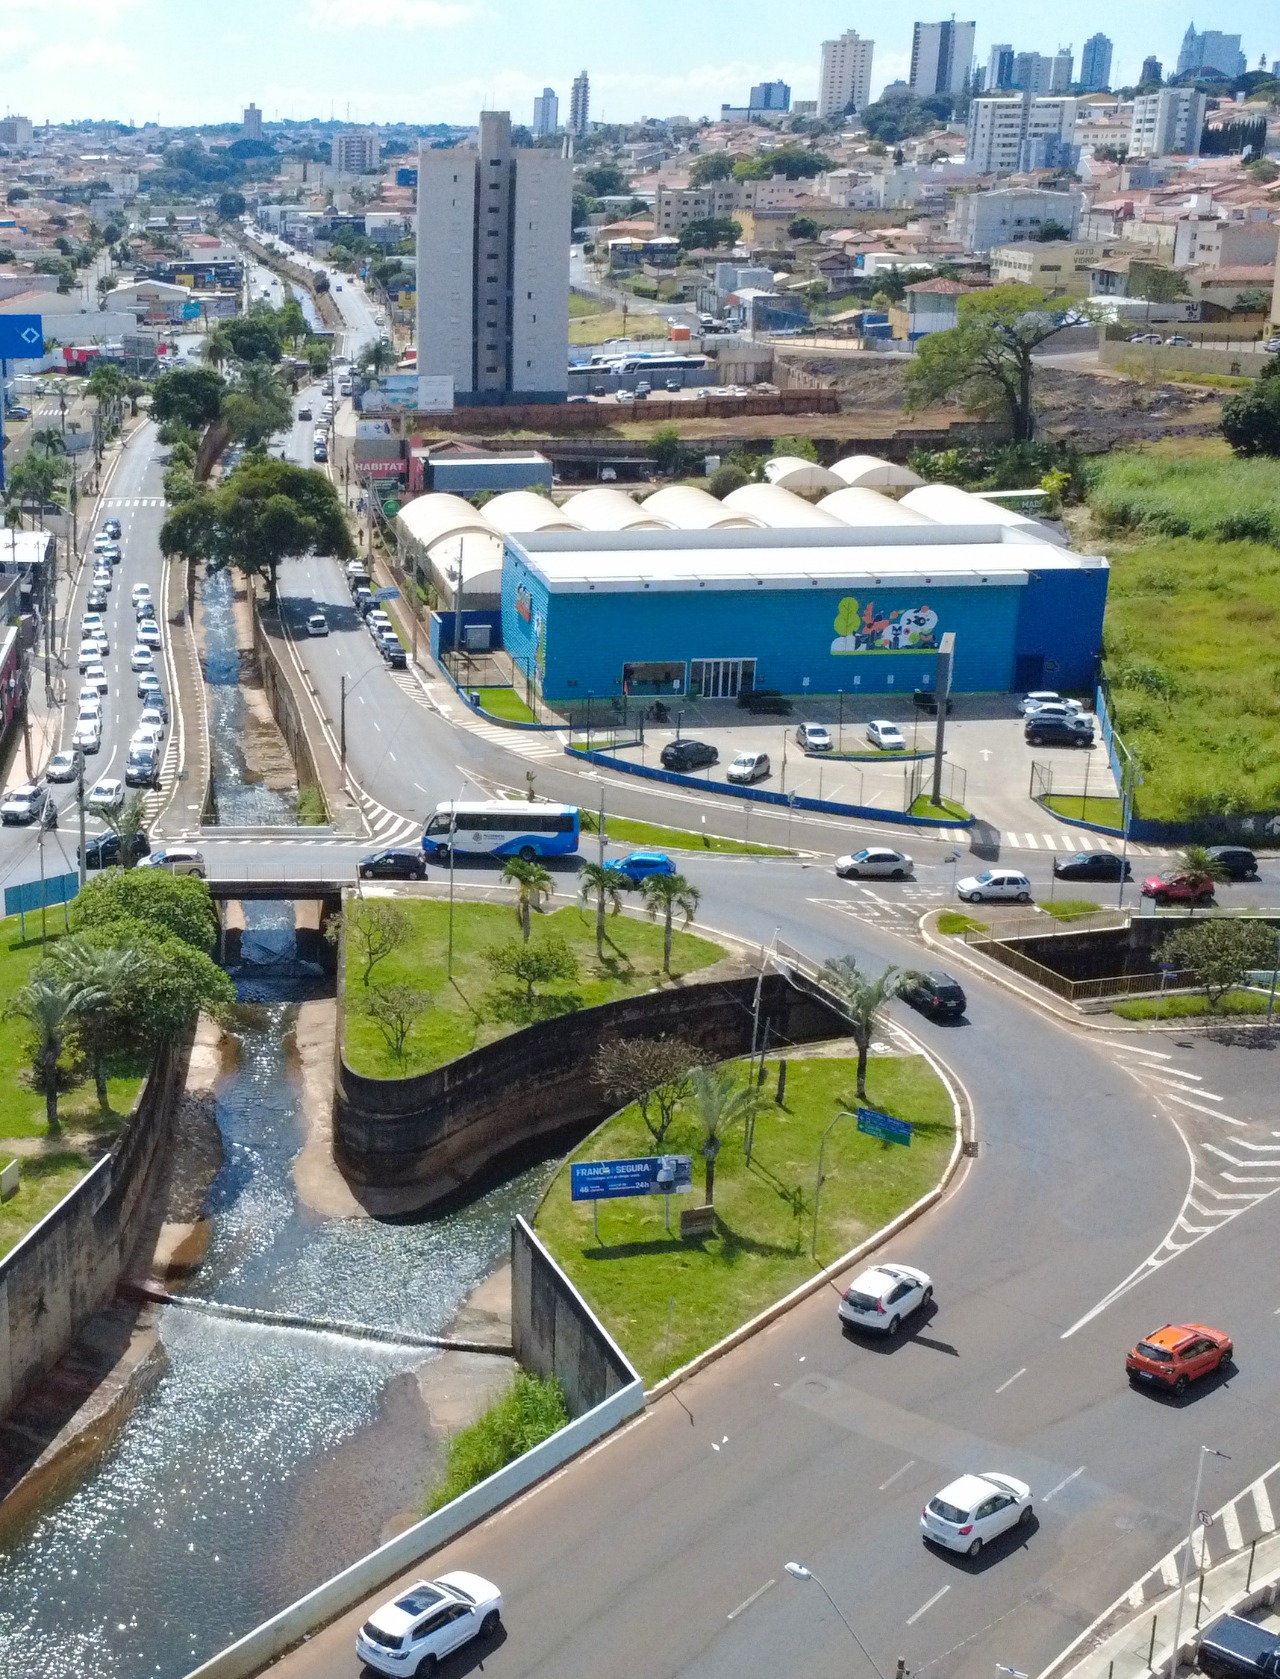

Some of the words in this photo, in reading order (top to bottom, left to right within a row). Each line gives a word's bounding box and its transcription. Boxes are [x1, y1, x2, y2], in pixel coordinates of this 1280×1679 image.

[1074, 248, 1095, 256] AUTO
[355, 463, 403, 471] HABITAT
[616, 1163, 650, 1173] SEGURA
[635, 1181, 650, 1189] 24h
